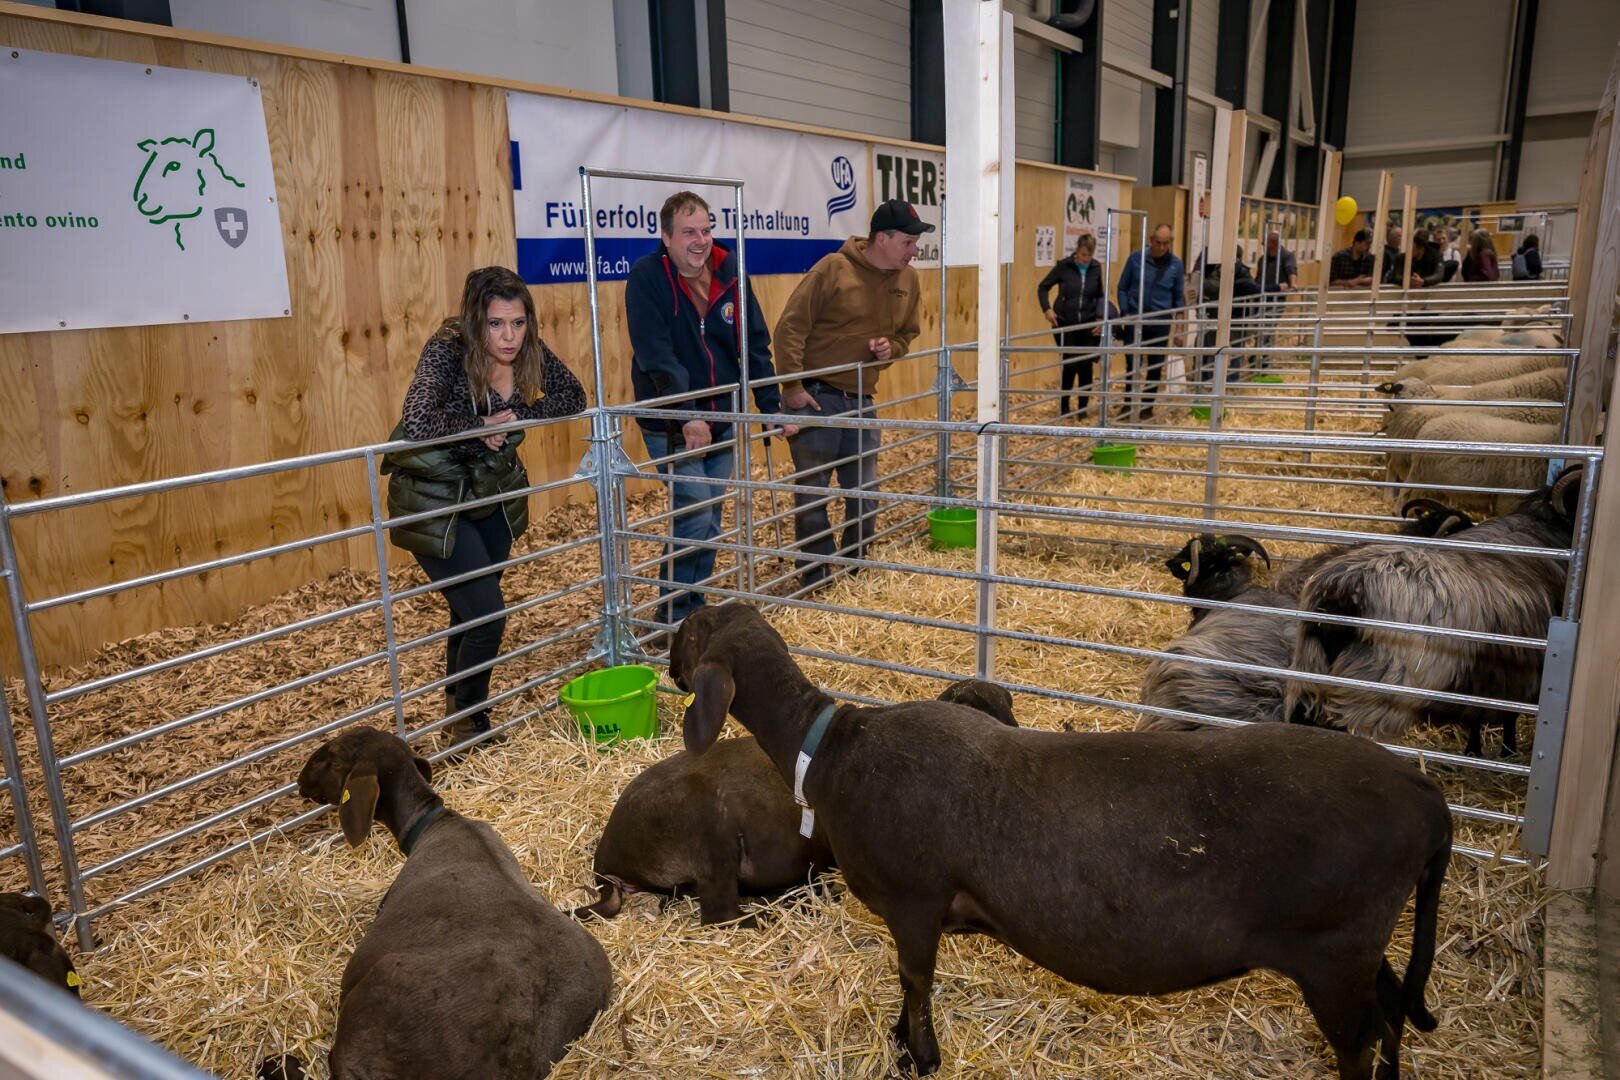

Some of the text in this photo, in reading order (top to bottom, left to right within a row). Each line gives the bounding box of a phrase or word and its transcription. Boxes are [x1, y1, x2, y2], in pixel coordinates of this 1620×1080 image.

[833, 158, 853, 189] UFA
[876, 153, 938, 207] TIER
[45, 211, 99, 228] ovino
